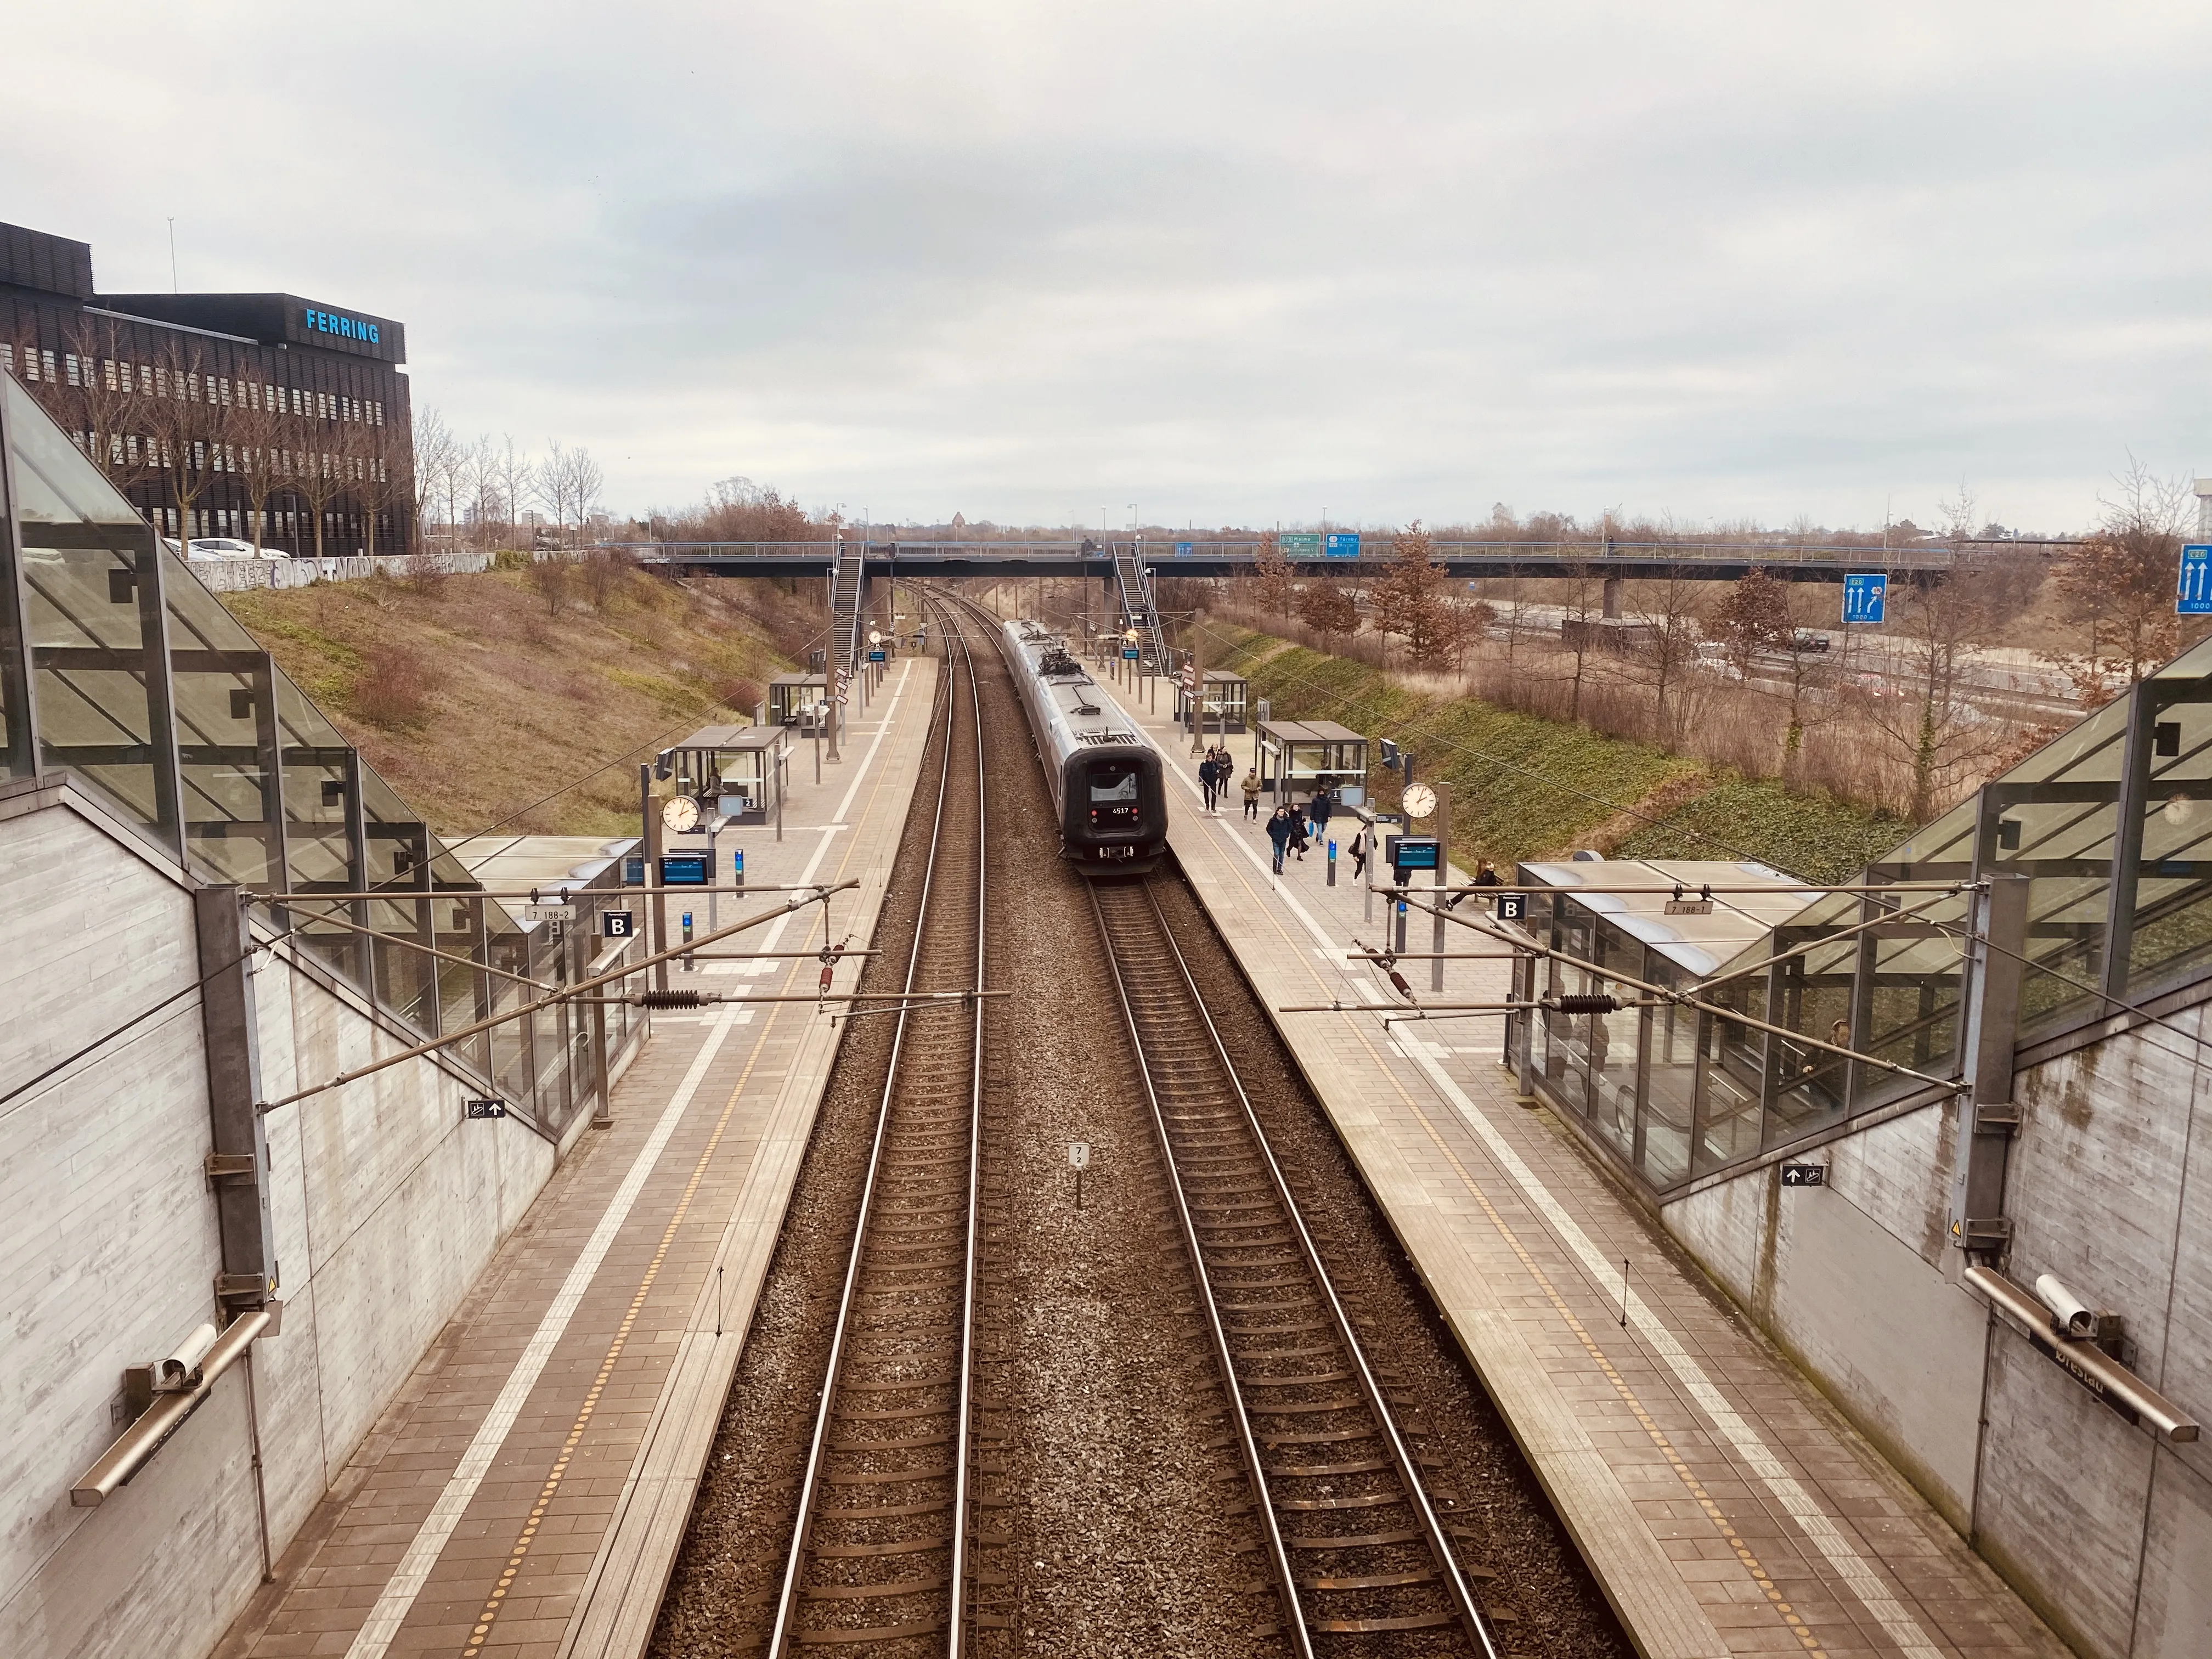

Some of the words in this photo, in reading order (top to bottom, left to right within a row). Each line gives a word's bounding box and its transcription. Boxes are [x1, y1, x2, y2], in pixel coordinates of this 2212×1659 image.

[307, 308, 379, 344] FERRING
[1505, 902, 1517, 917] B
[612, 919, 625, 935] B
[1076, 1147, 1082, 1155] 7
